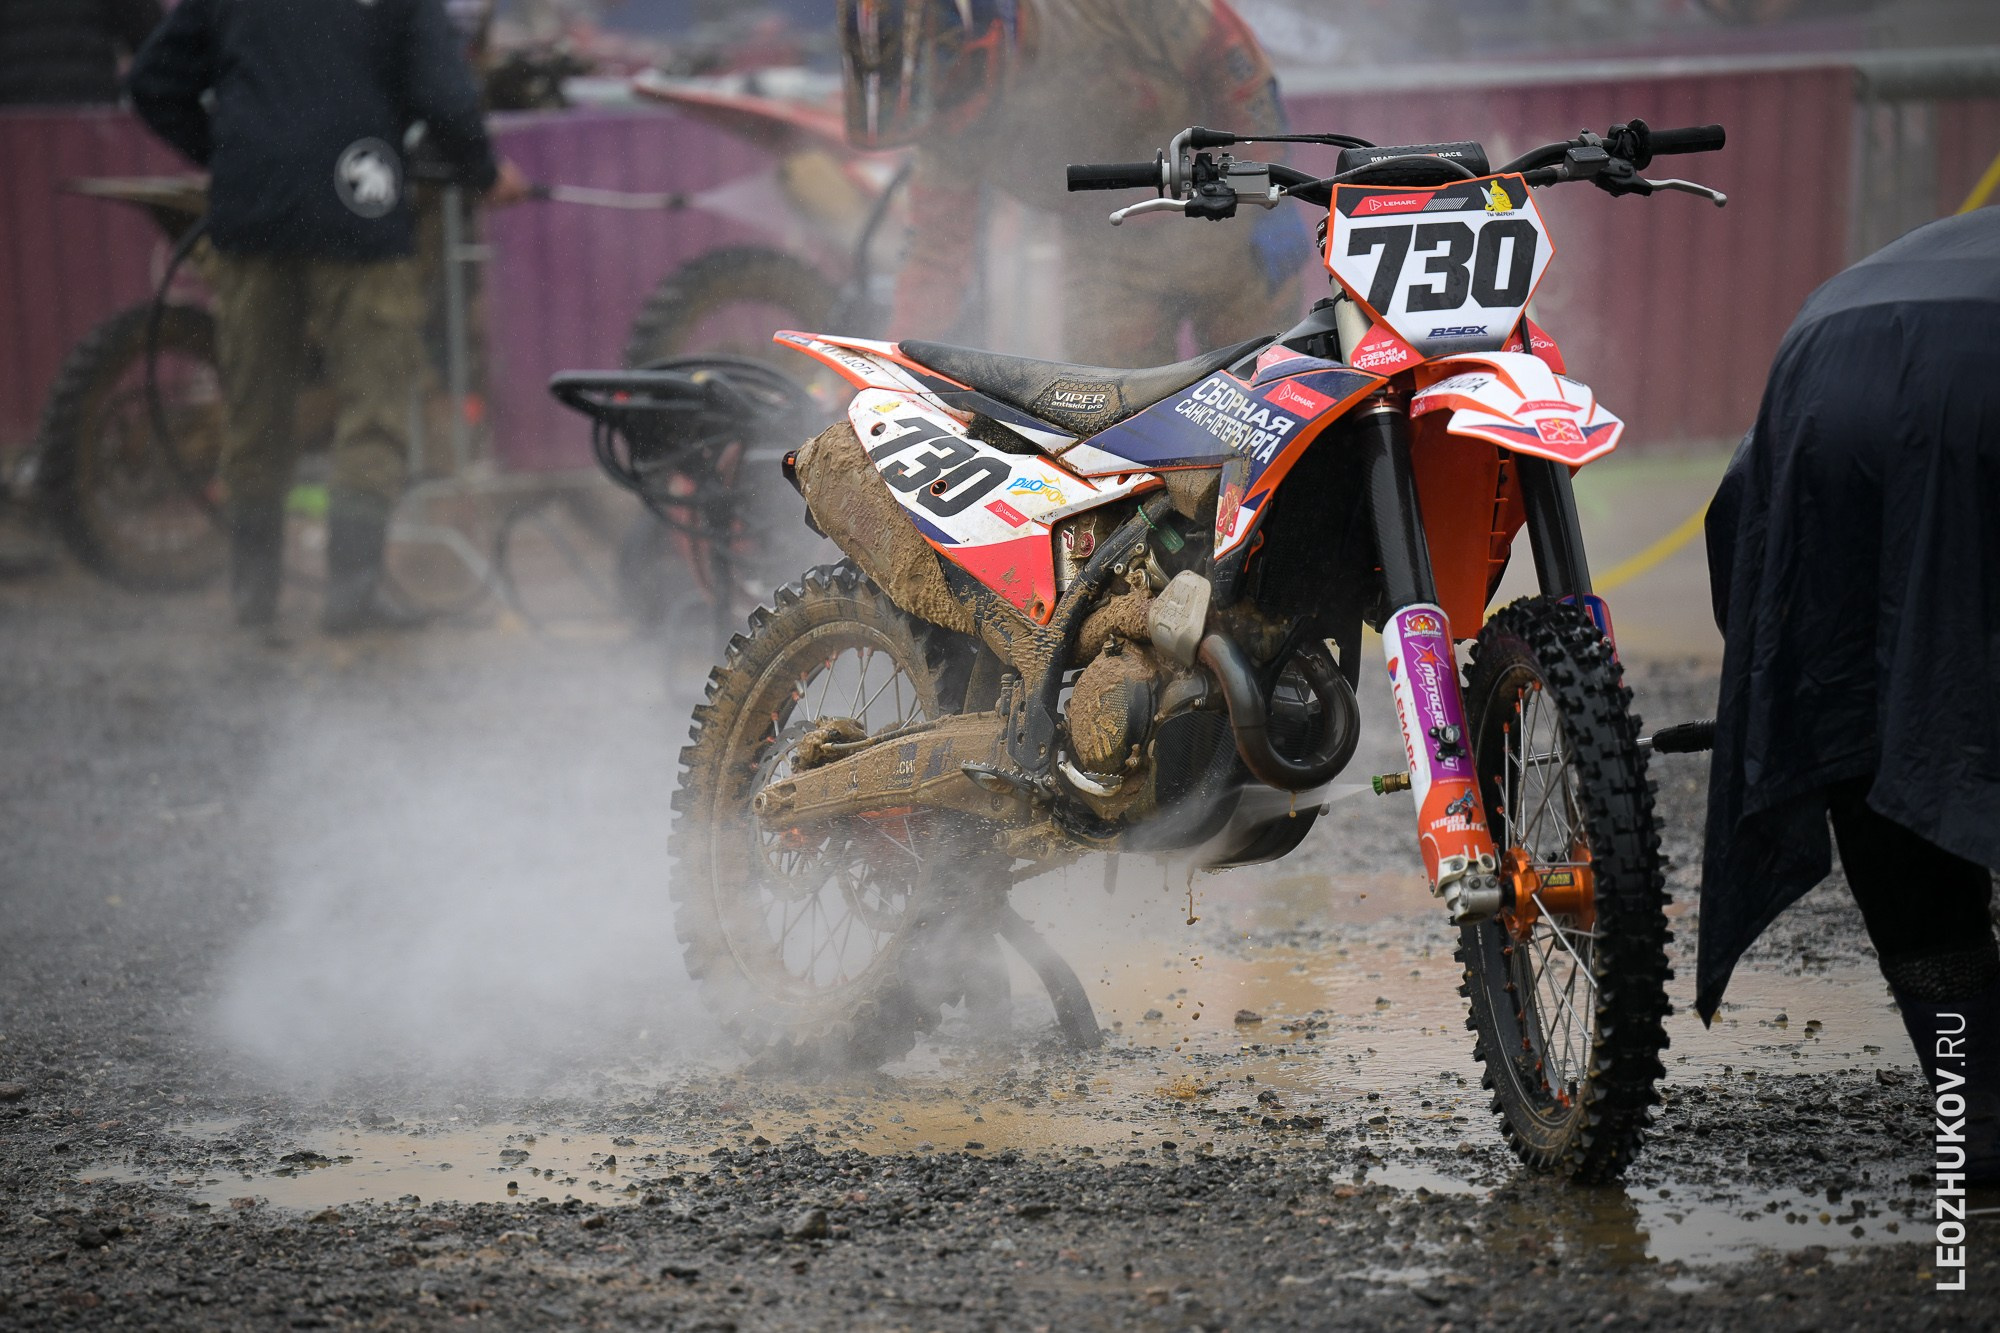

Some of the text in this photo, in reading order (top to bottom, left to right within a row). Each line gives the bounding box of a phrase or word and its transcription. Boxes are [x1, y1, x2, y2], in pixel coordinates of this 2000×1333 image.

[1383, 199, 1417, 207] LEMARC
[1347, 219, 1538, 316] 730
[1428, 325, 1488, 338] BSGX
[1051, 401, 1086, 410] antiskid
[1055, 390, 1106, 404] VIPER
[1192, 378, 1295, 436] СБОРНАЯ
[1290, 392, 1316, 409] LEMARC
[1175, 399, 1281, 464] САНКТ-ПЕТЕРБУРГА
[867, 416, 1012, 517] 730
[1393, 683, 1417, 774] LEMARC
